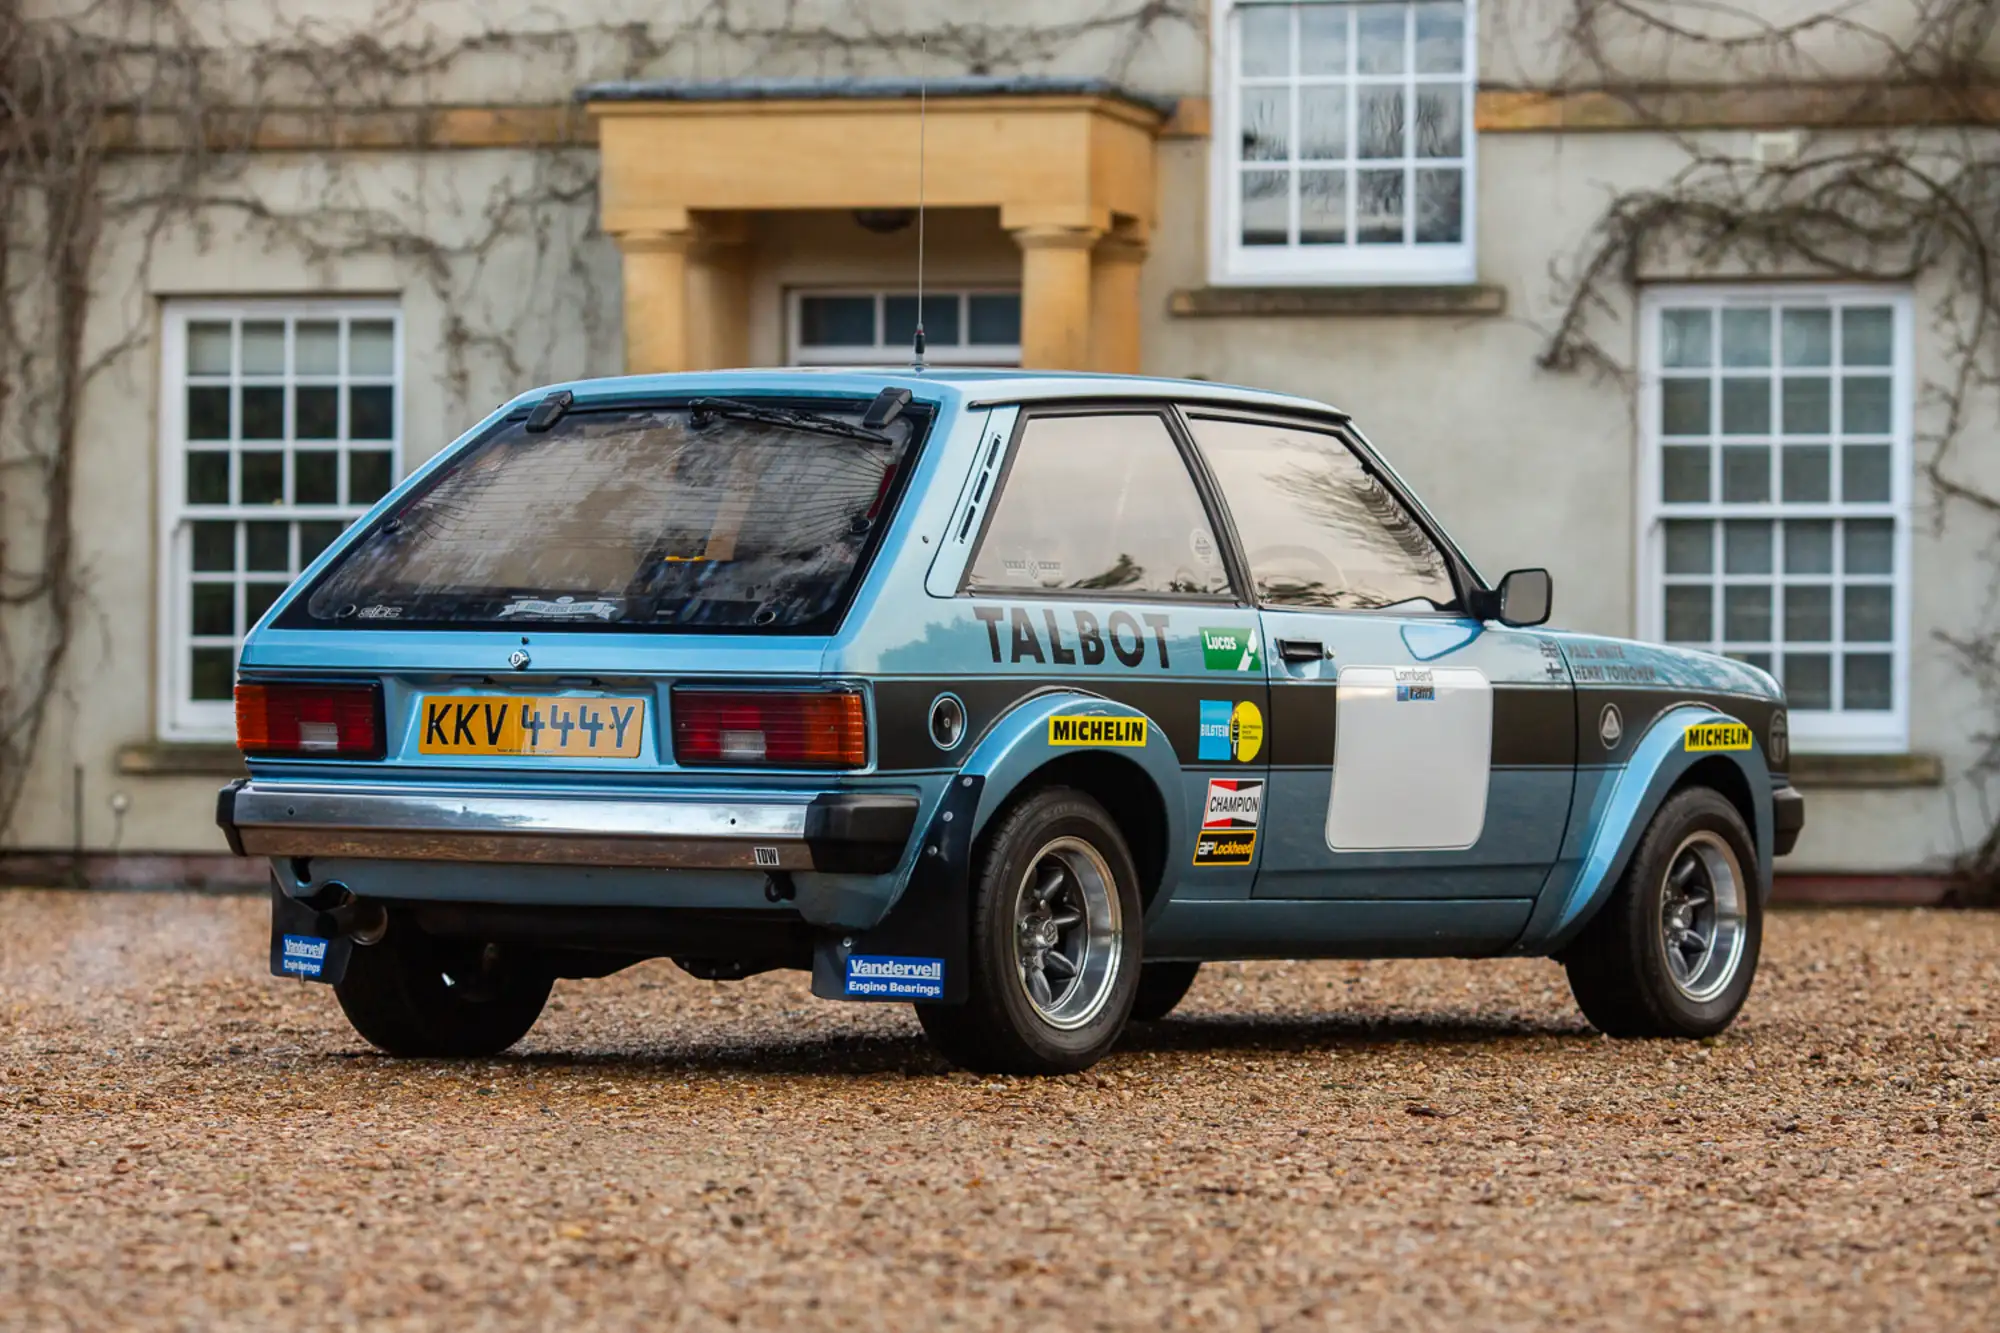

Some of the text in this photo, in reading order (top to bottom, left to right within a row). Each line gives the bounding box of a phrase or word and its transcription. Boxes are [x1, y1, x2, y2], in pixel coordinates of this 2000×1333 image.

[974, 606, 1170, 669] TALBOT
[1204, 631, 1237, 651] Lucas
[1394, 668, 1432, 681] Lombard
[1573, 664, 1604, 680] HENRI
[426, 704, 635, 748] KKV 444Y
[1053, 719, 1143, 741] MICHELIN
[1200, 723, 1229, 737] BILSTEIN
[1688, 727, 1749, 747] MICHELIN
[1210, 796, 1258, 813] CHAMPION
[756, 848, 777, 865] TOW
[285, 939, 326, 957] Vandervell
[850, 959, 941, 978] Vandervell
[849, 981, 940, 995] Engine Bearings
